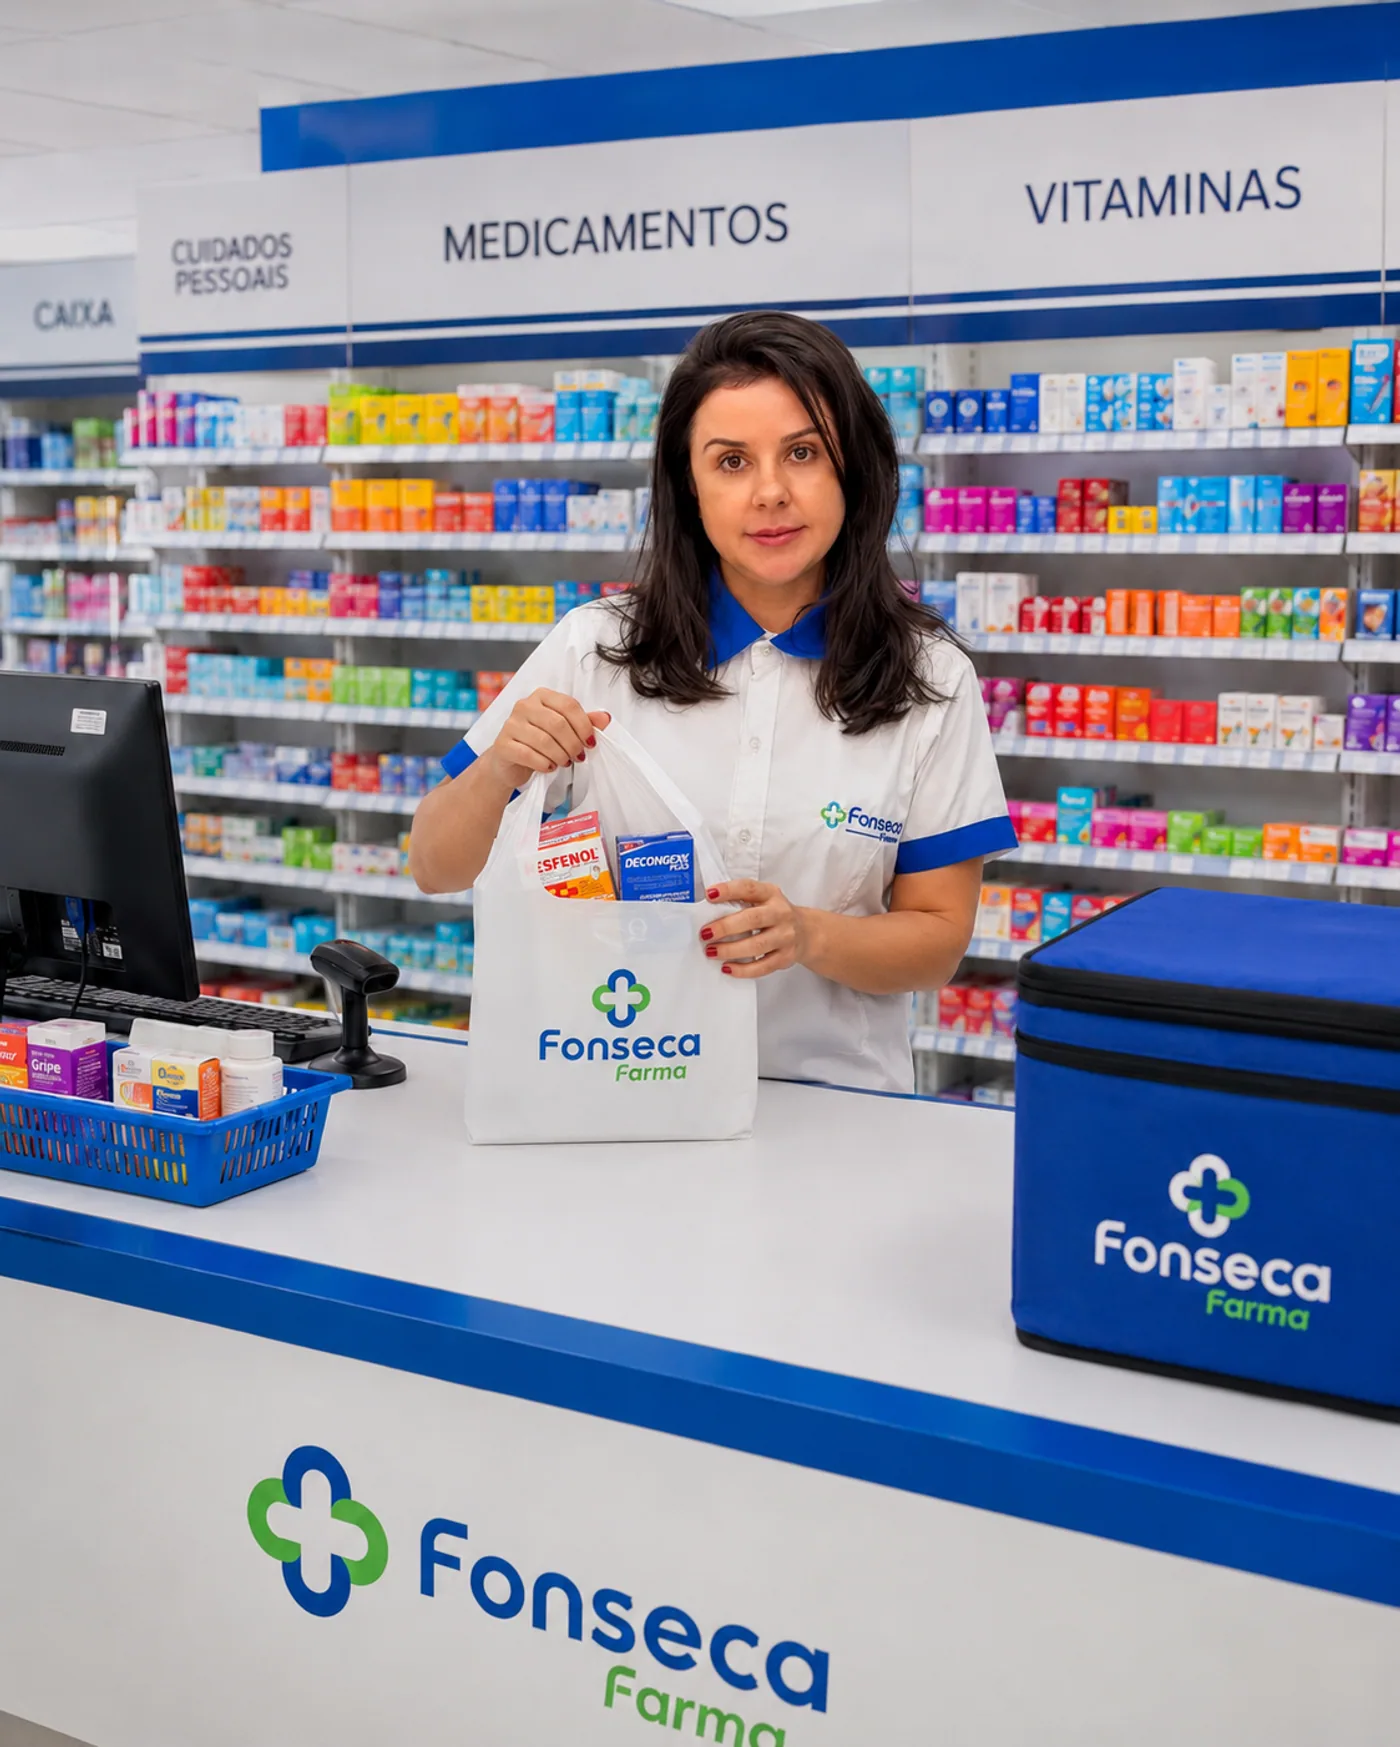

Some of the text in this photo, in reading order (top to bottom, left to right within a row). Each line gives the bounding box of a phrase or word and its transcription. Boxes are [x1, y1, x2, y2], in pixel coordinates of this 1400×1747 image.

[1025, 165, 1302, 225] VITAMINAS
[171, 232, 293, 265] CUIDADOS
[444, 202, 789, 262] MEDICAMENTOS
[175, 263, 290, 296] PESSOAIS
[34, 299, 115, 330] CAIXA
[537, 847, 599, 874] ESFENOL
[539, 1029, 701, 1061] Fonseca
[31, 1058, 61, 1075] Gripe
[615, 1064, 687, 1082] Farma
[1094, 1219, 1331, 1303] Fonseca
[1206, 1289, 1310, 1331] Farma
[420, 1517, 829, 1714] Fonseca
[604, 1665, 786, 1747] Farma
